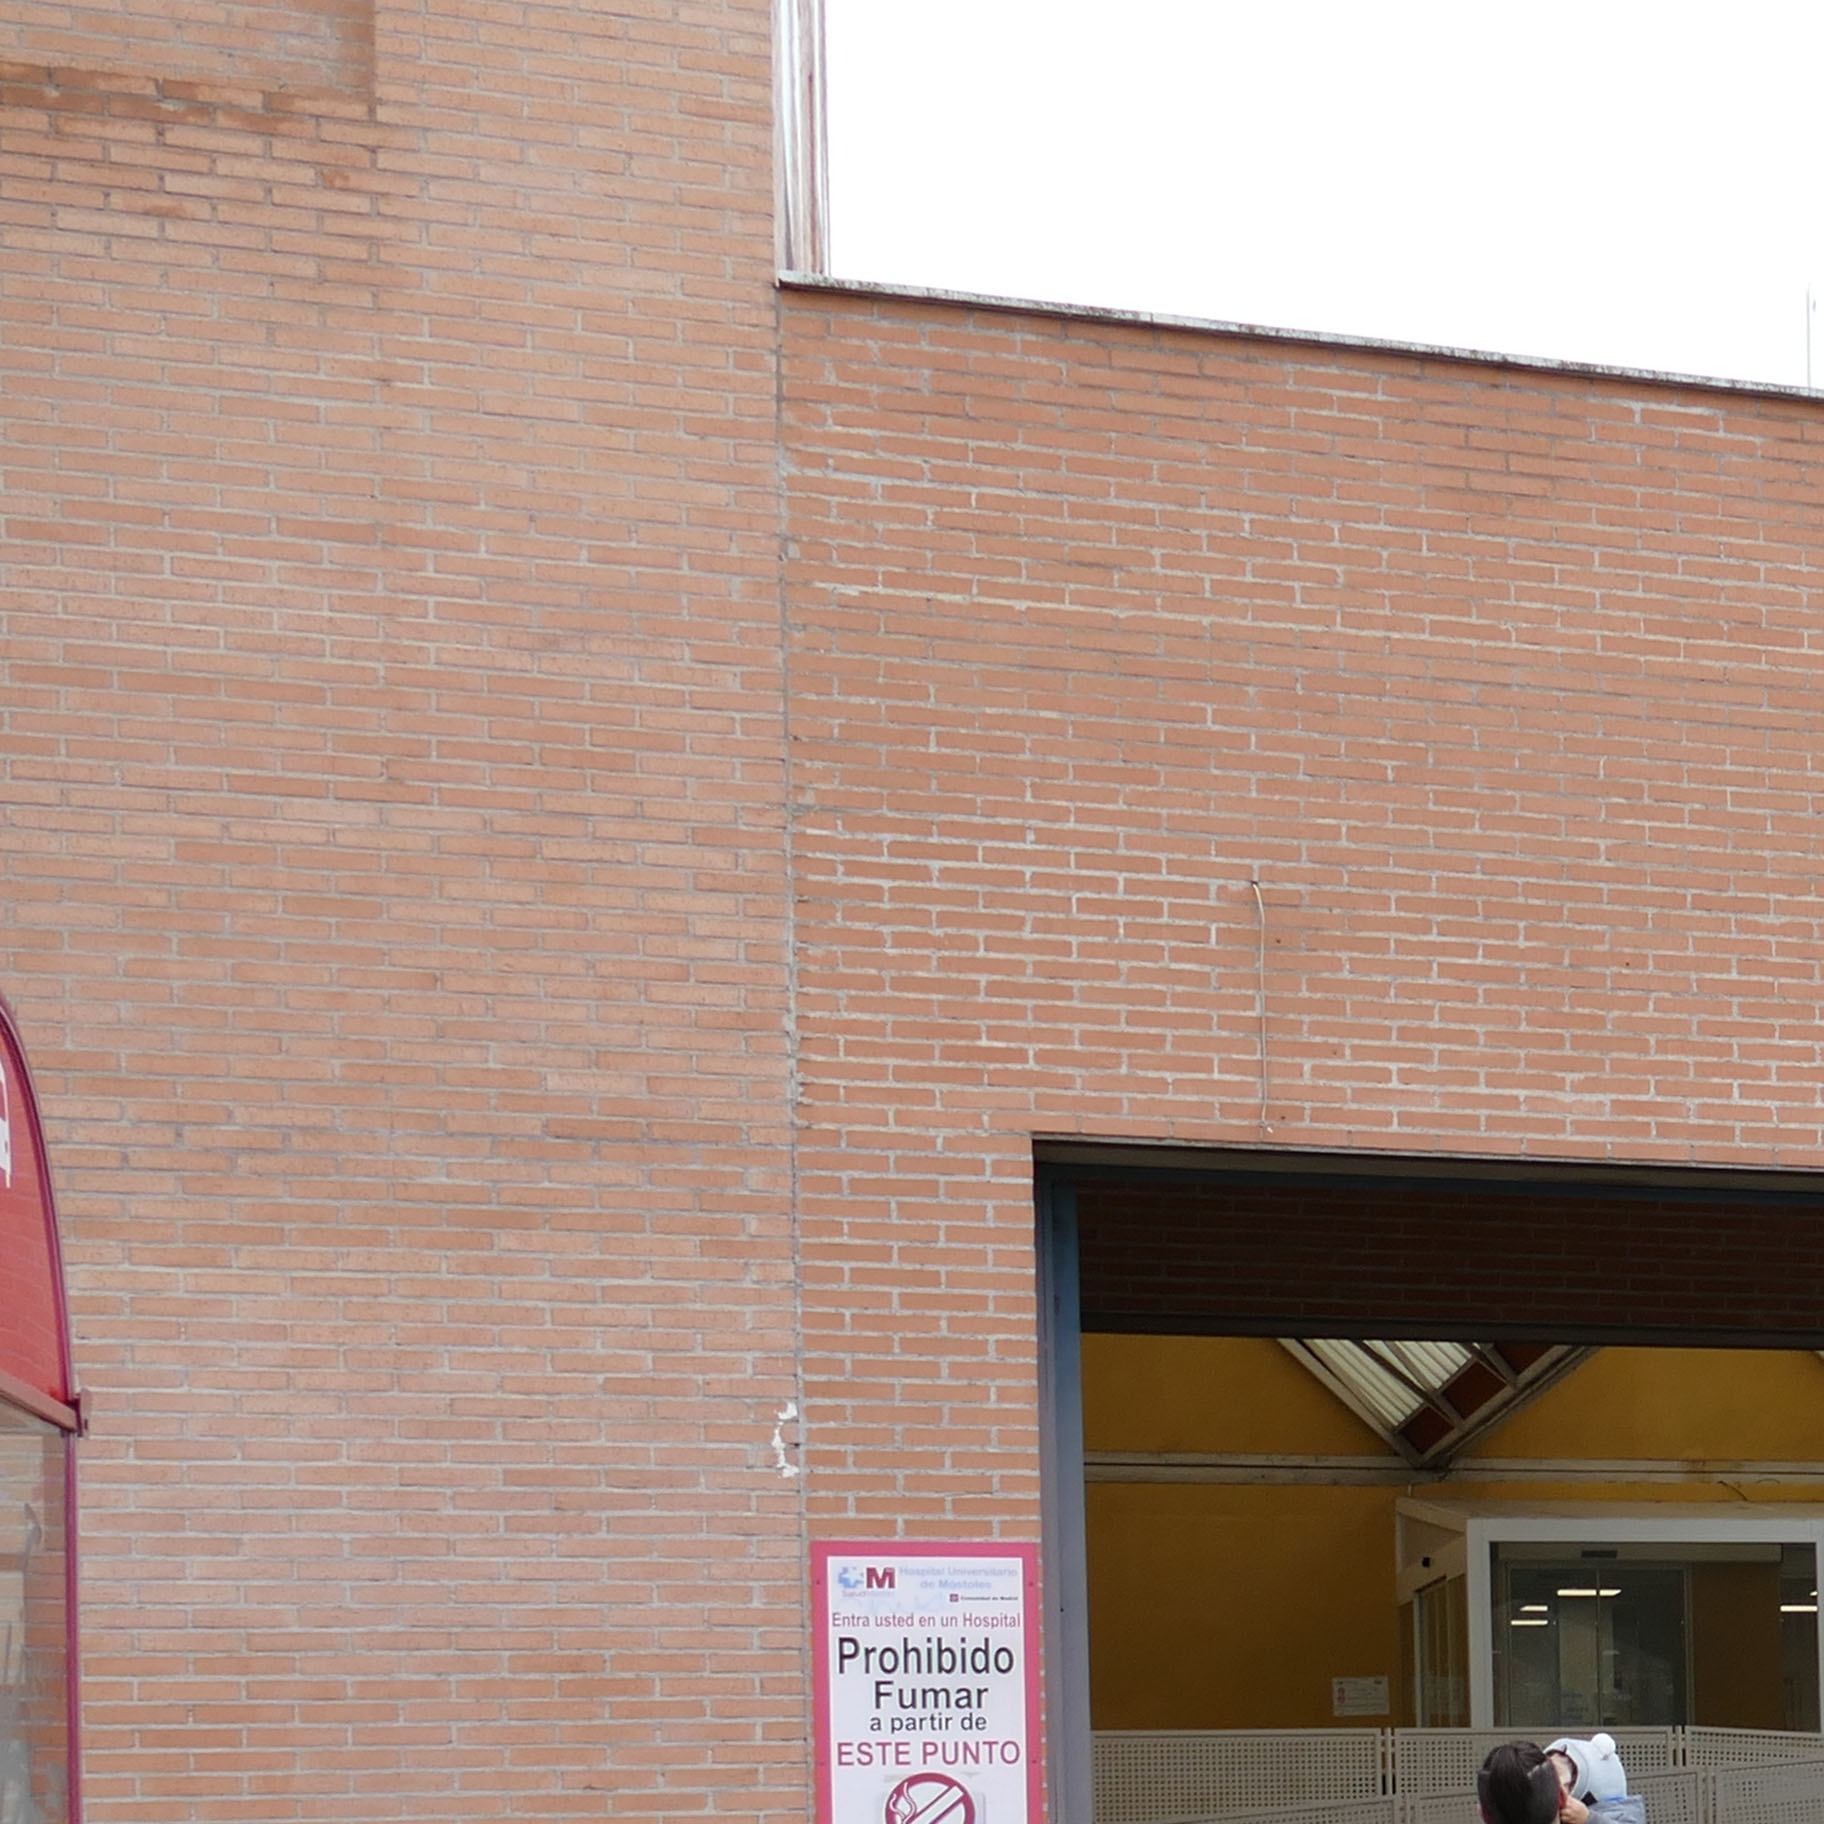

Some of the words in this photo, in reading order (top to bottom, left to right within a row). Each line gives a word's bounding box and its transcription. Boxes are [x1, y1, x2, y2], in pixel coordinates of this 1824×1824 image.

[832, 1612, 870, 1627] Entra
[875, 1613, 914, 1627] usted
[919, 1616, 936, 1627] en
[941, 1616, 958, 1627] un
[963, 1612, 1021, 1629] Hospital
[838, 1637, 1014, 1674] Prohibido
[874, 1681, 989, 1709] Fumar
[870, 1717, 882, 1731] a
[891, 1713, 953, 1734] partir
[960, 1713, 987, 1731] de
[837, 1742, 911, 1766] ESTE
[923, 1740, 1021, 1765] PUNTO
